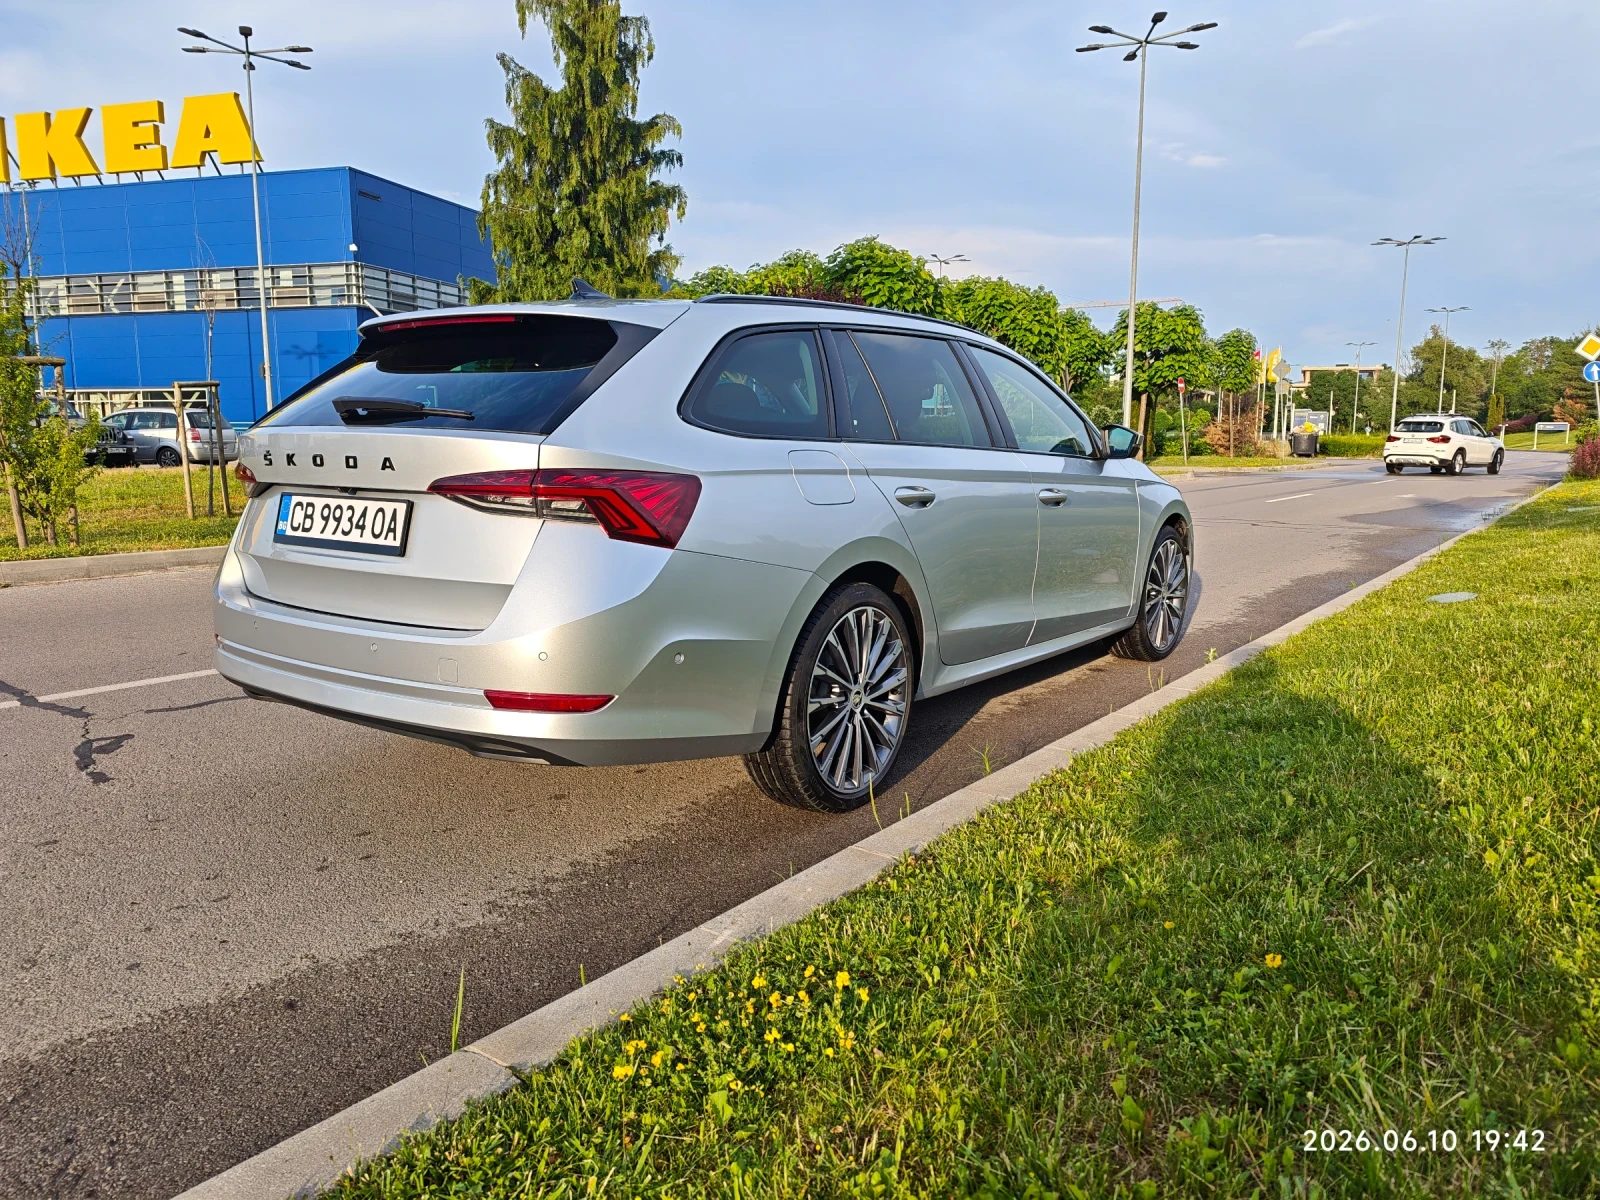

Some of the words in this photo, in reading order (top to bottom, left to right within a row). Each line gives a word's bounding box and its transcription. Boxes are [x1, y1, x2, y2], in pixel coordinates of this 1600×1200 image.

[0, 92, 264, 183] KEA
[263, 450, 396, 471] ŠKODA
[291, 501, 315, 533] CB
[320, 503, 368, 538] 9934
[371, 507, 397, 542] OA
